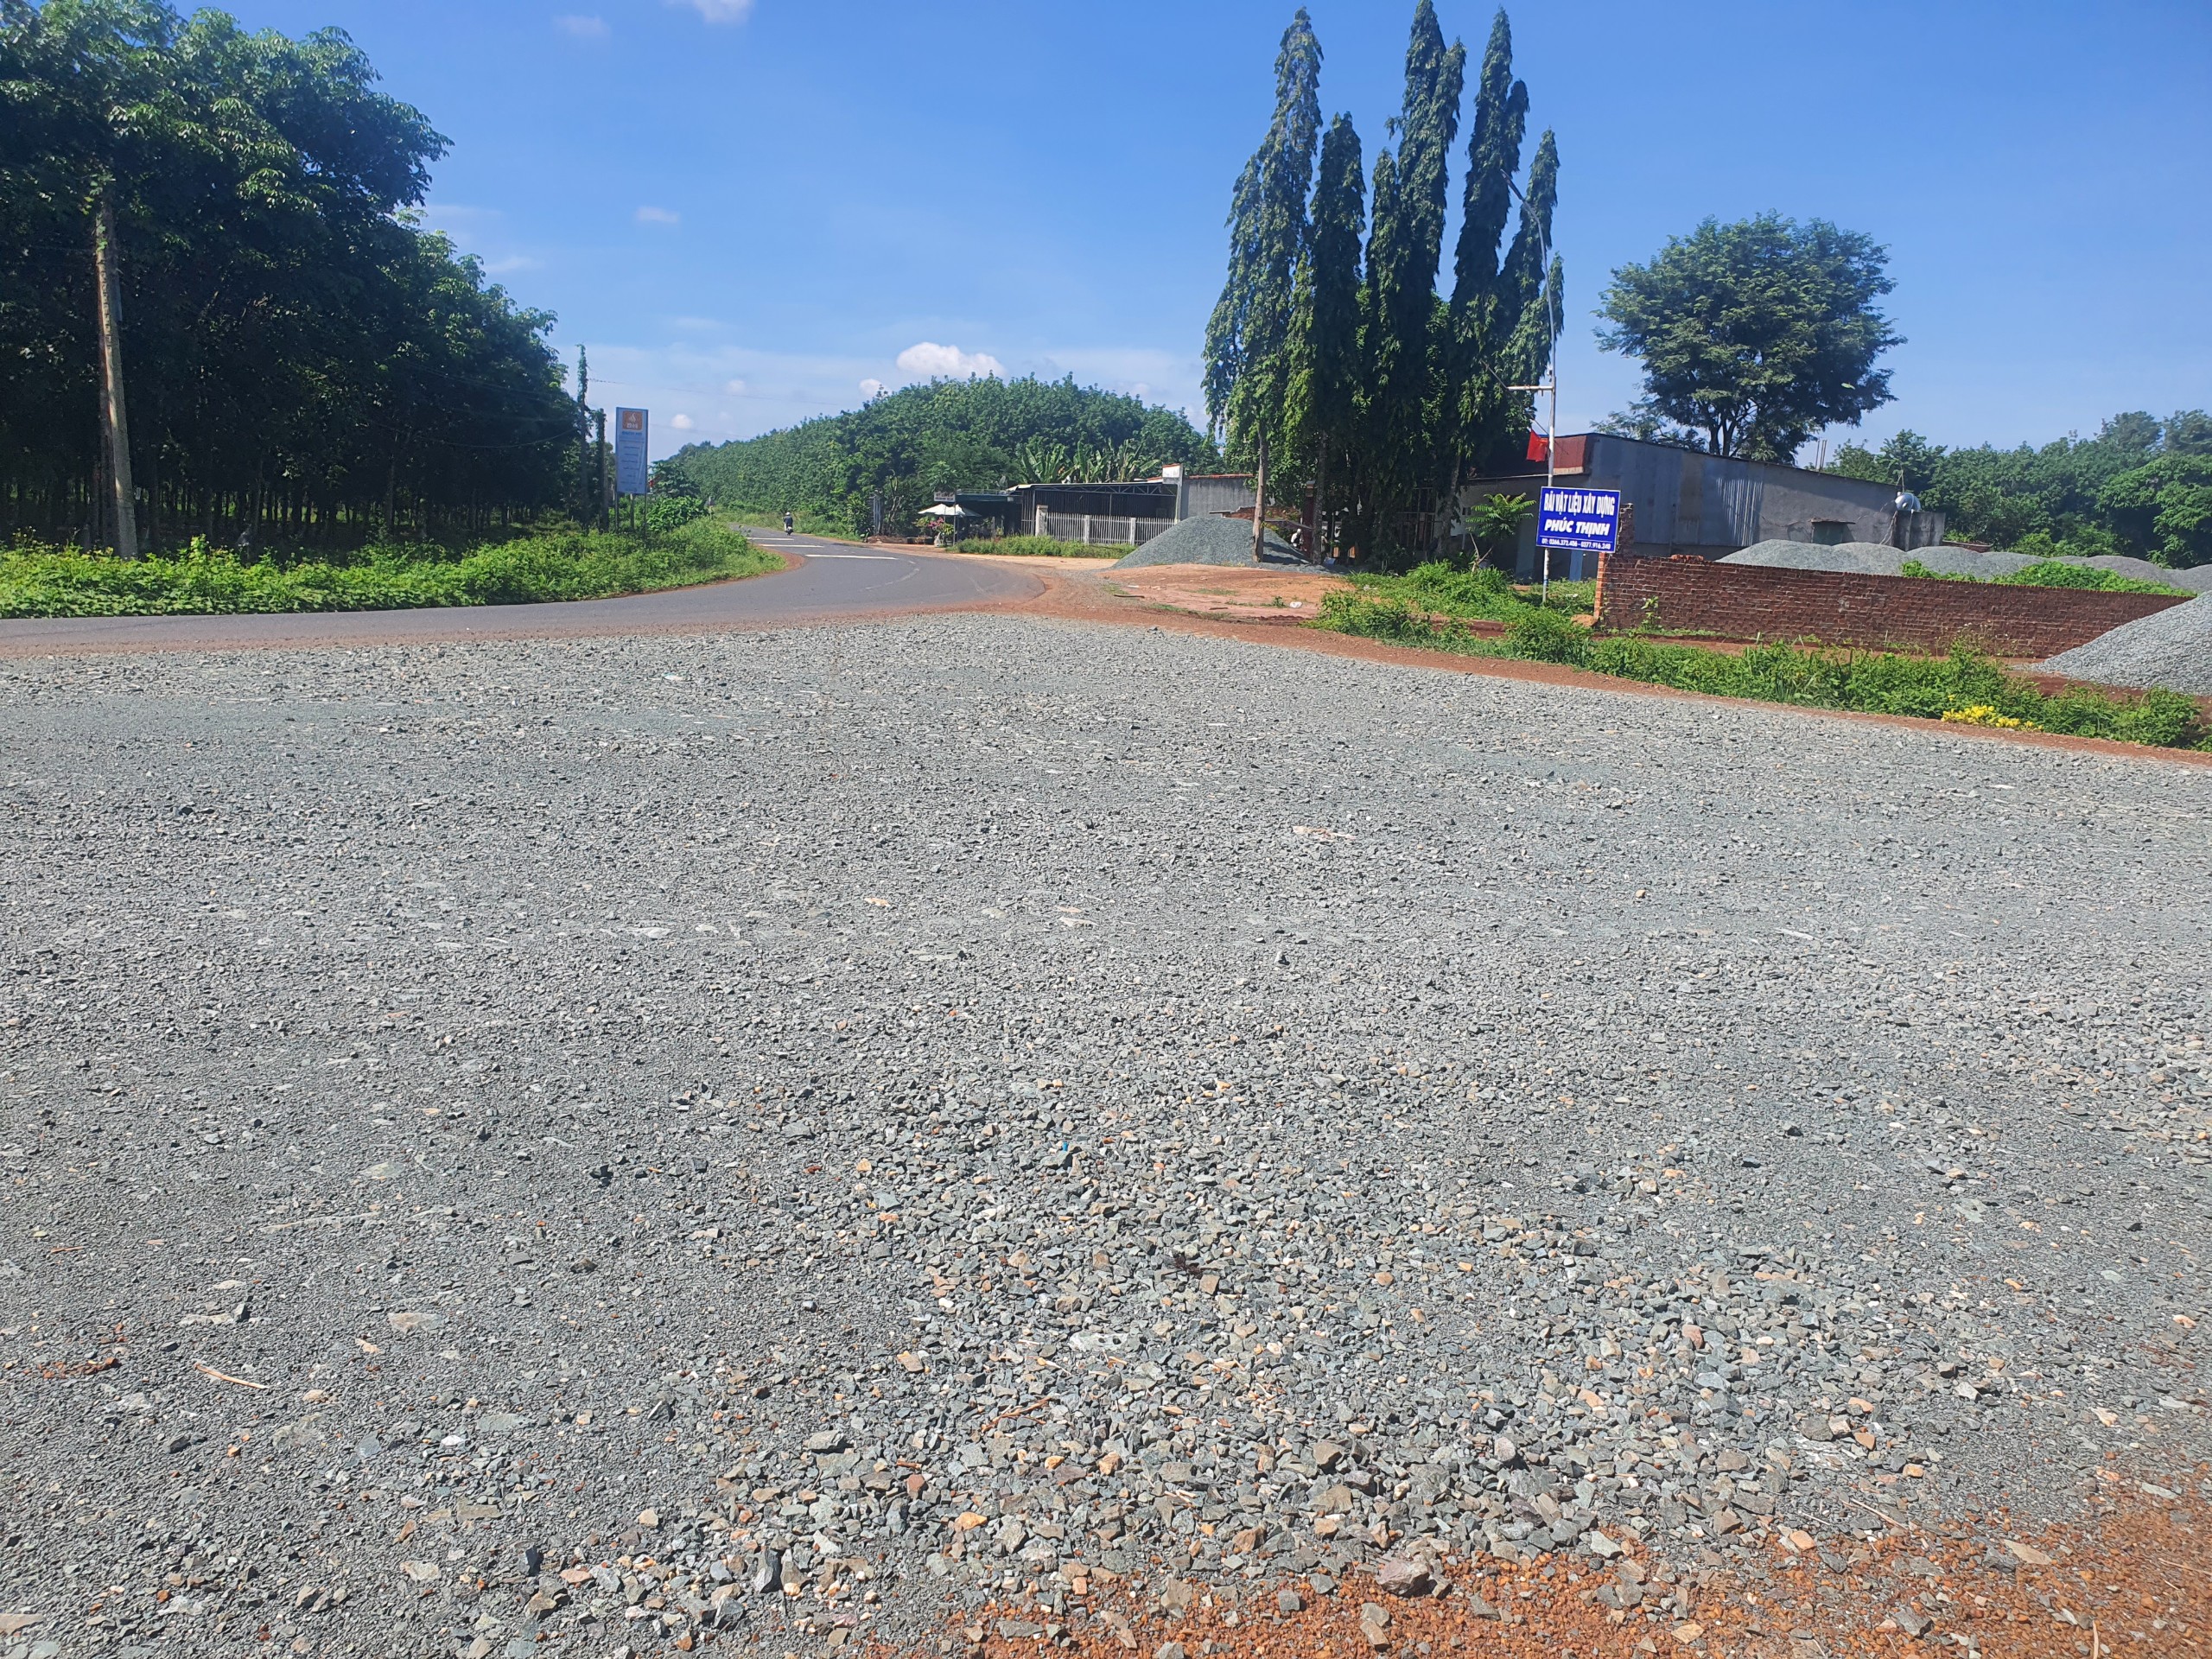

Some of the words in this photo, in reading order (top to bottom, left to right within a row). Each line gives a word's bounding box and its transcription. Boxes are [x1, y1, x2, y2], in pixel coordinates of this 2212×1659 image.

[1555, 491, 1568, 515] VẬT
[1567, 491, 1582, 516] LIỆU
[1582, 492, 1596, 514] XÂY
[1596, 494, 1616, 518] DỰNG
[1544, 517, 1574, 532] PHÚC
[1575, 521, 1611, 537] THỊNH
